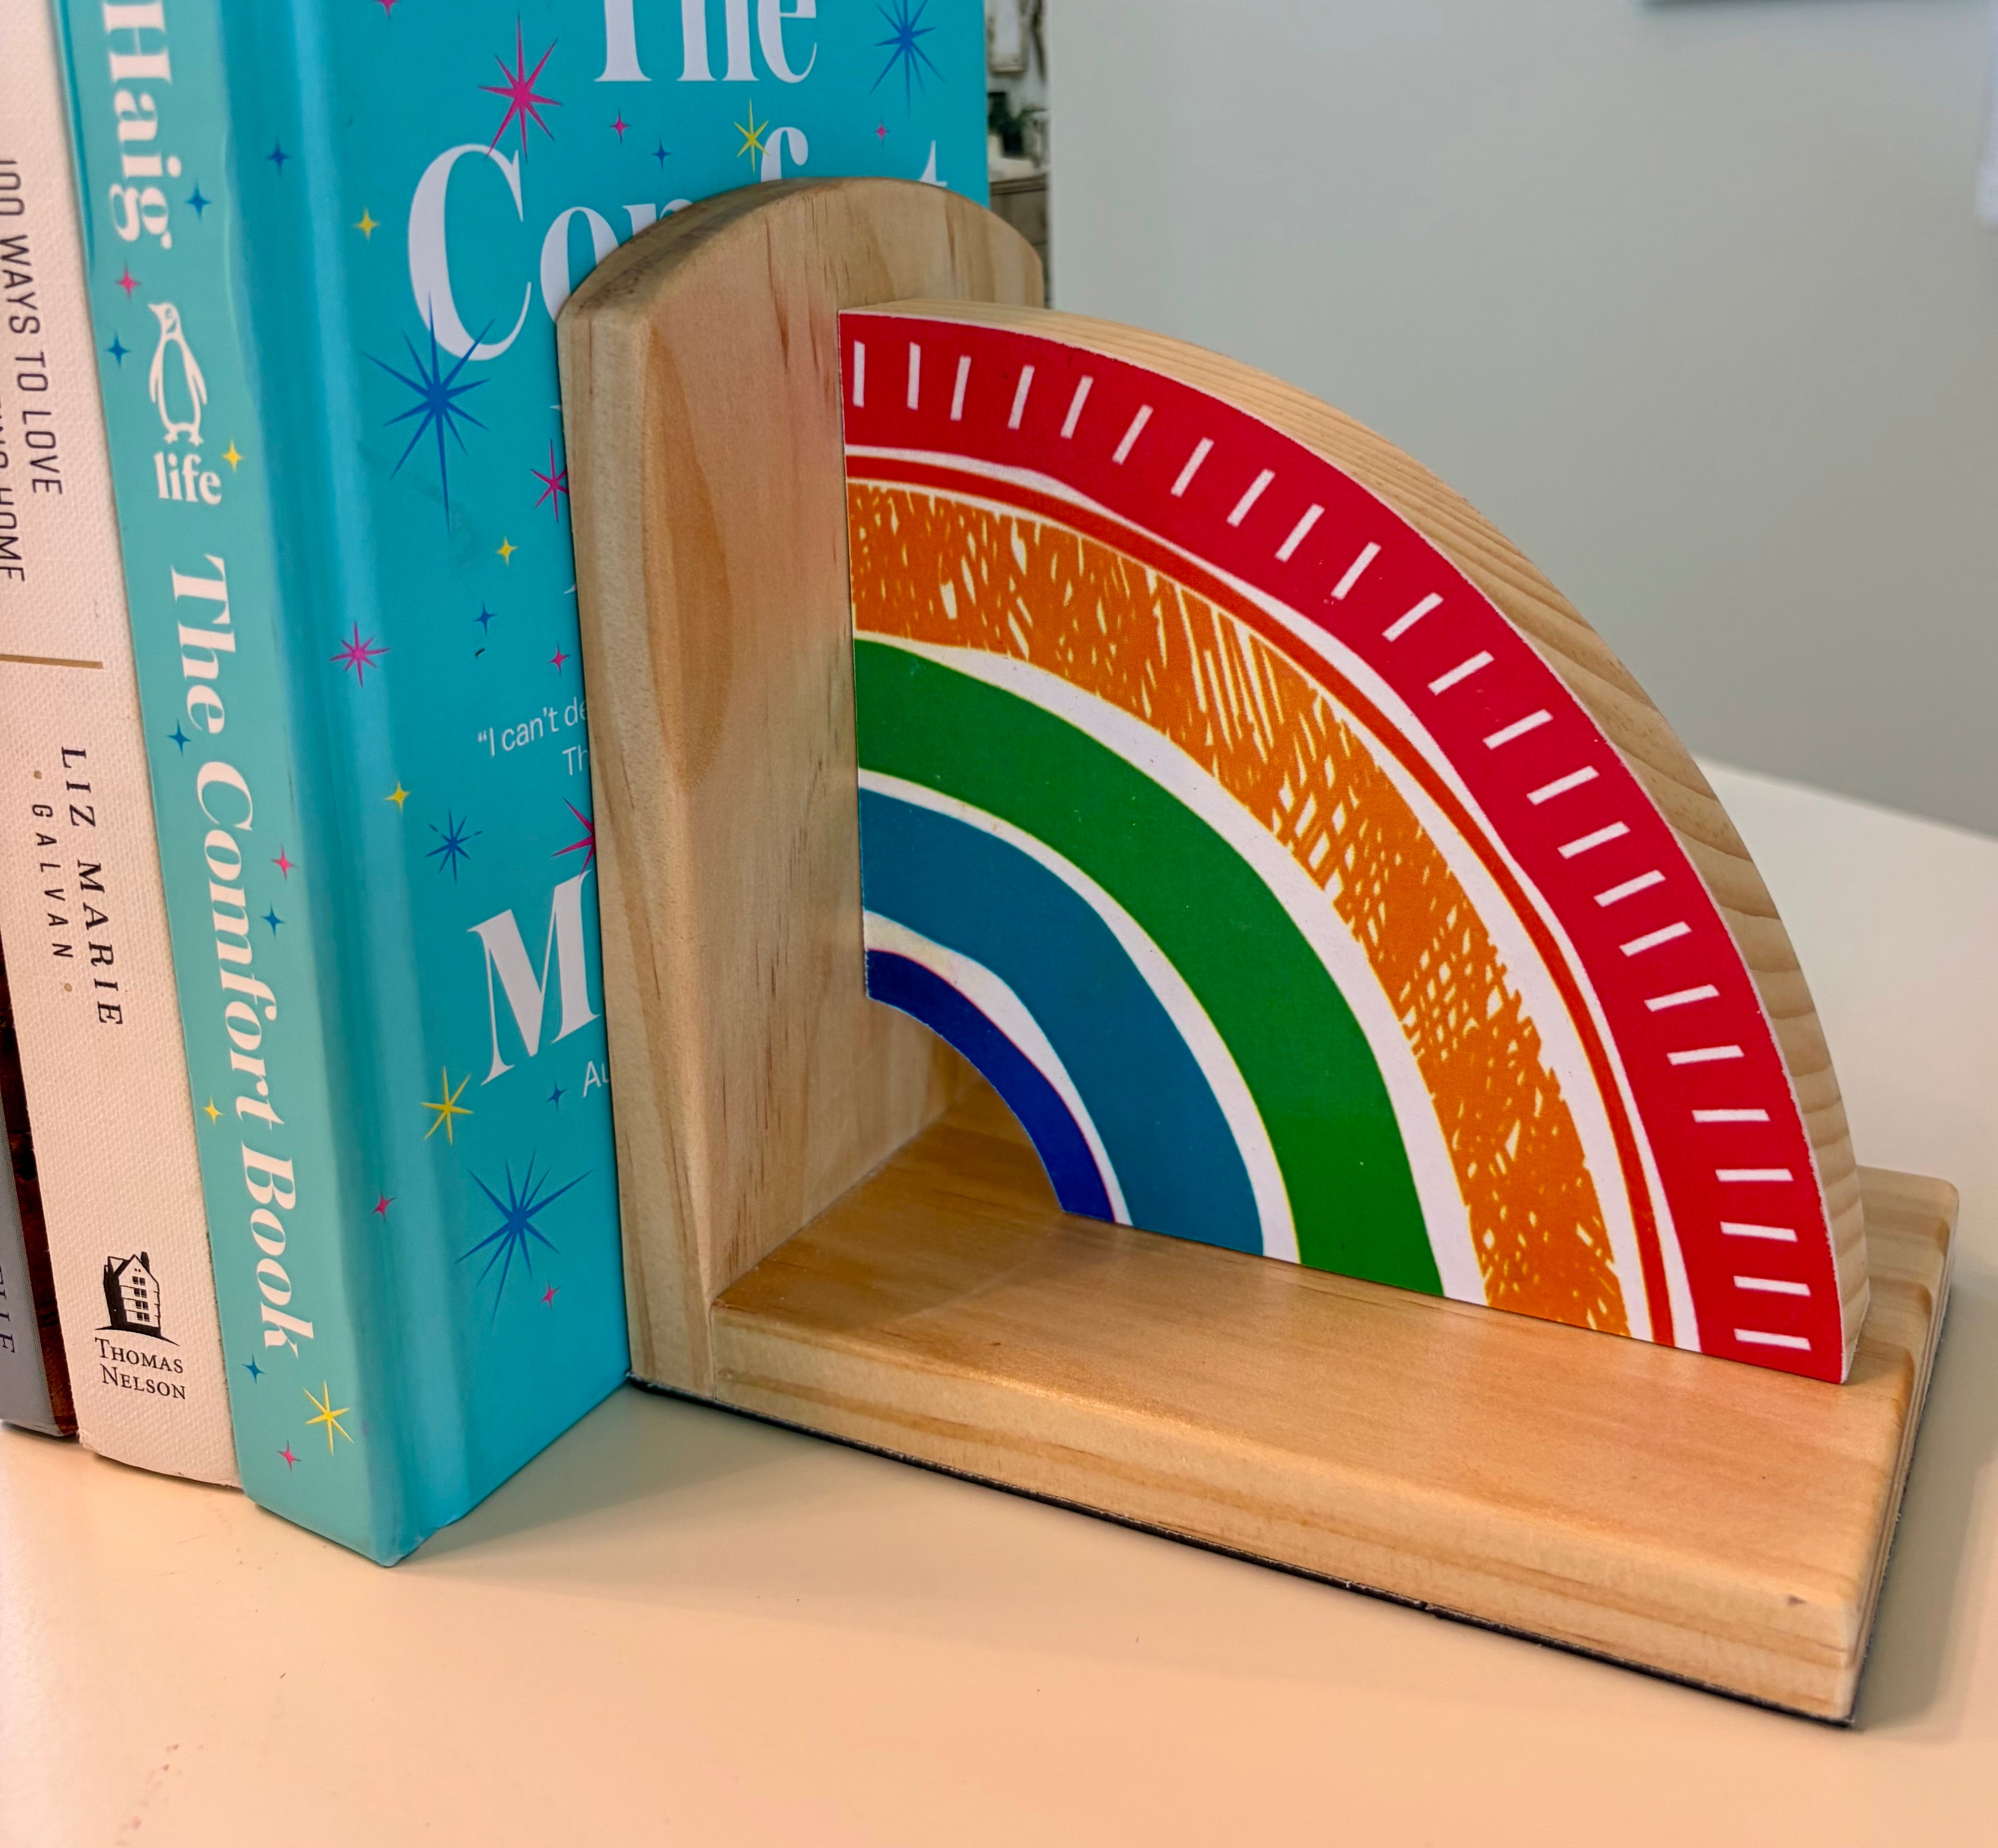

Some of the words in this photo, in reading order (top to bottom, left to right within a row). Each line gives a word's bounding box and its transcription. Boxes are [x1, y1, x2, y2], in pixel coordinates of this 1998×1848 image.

[103, 0, 182, 249] Haig
[0, 235, 41, 334] WAYS
[15, 351, 48, 392] TO
[22, 410, 62, 494] LOVE
[153, 451, 222, 505] life
[171, 554, 236, 735] The
[61, 746, 96, 827] LIZ
[32, 804, 73, 958] GALVAN
[78, 859, 123, 1025] MARIE
[197, 761, 285, 1130] Comfort
[241, 1142, 314, 1358] Book
